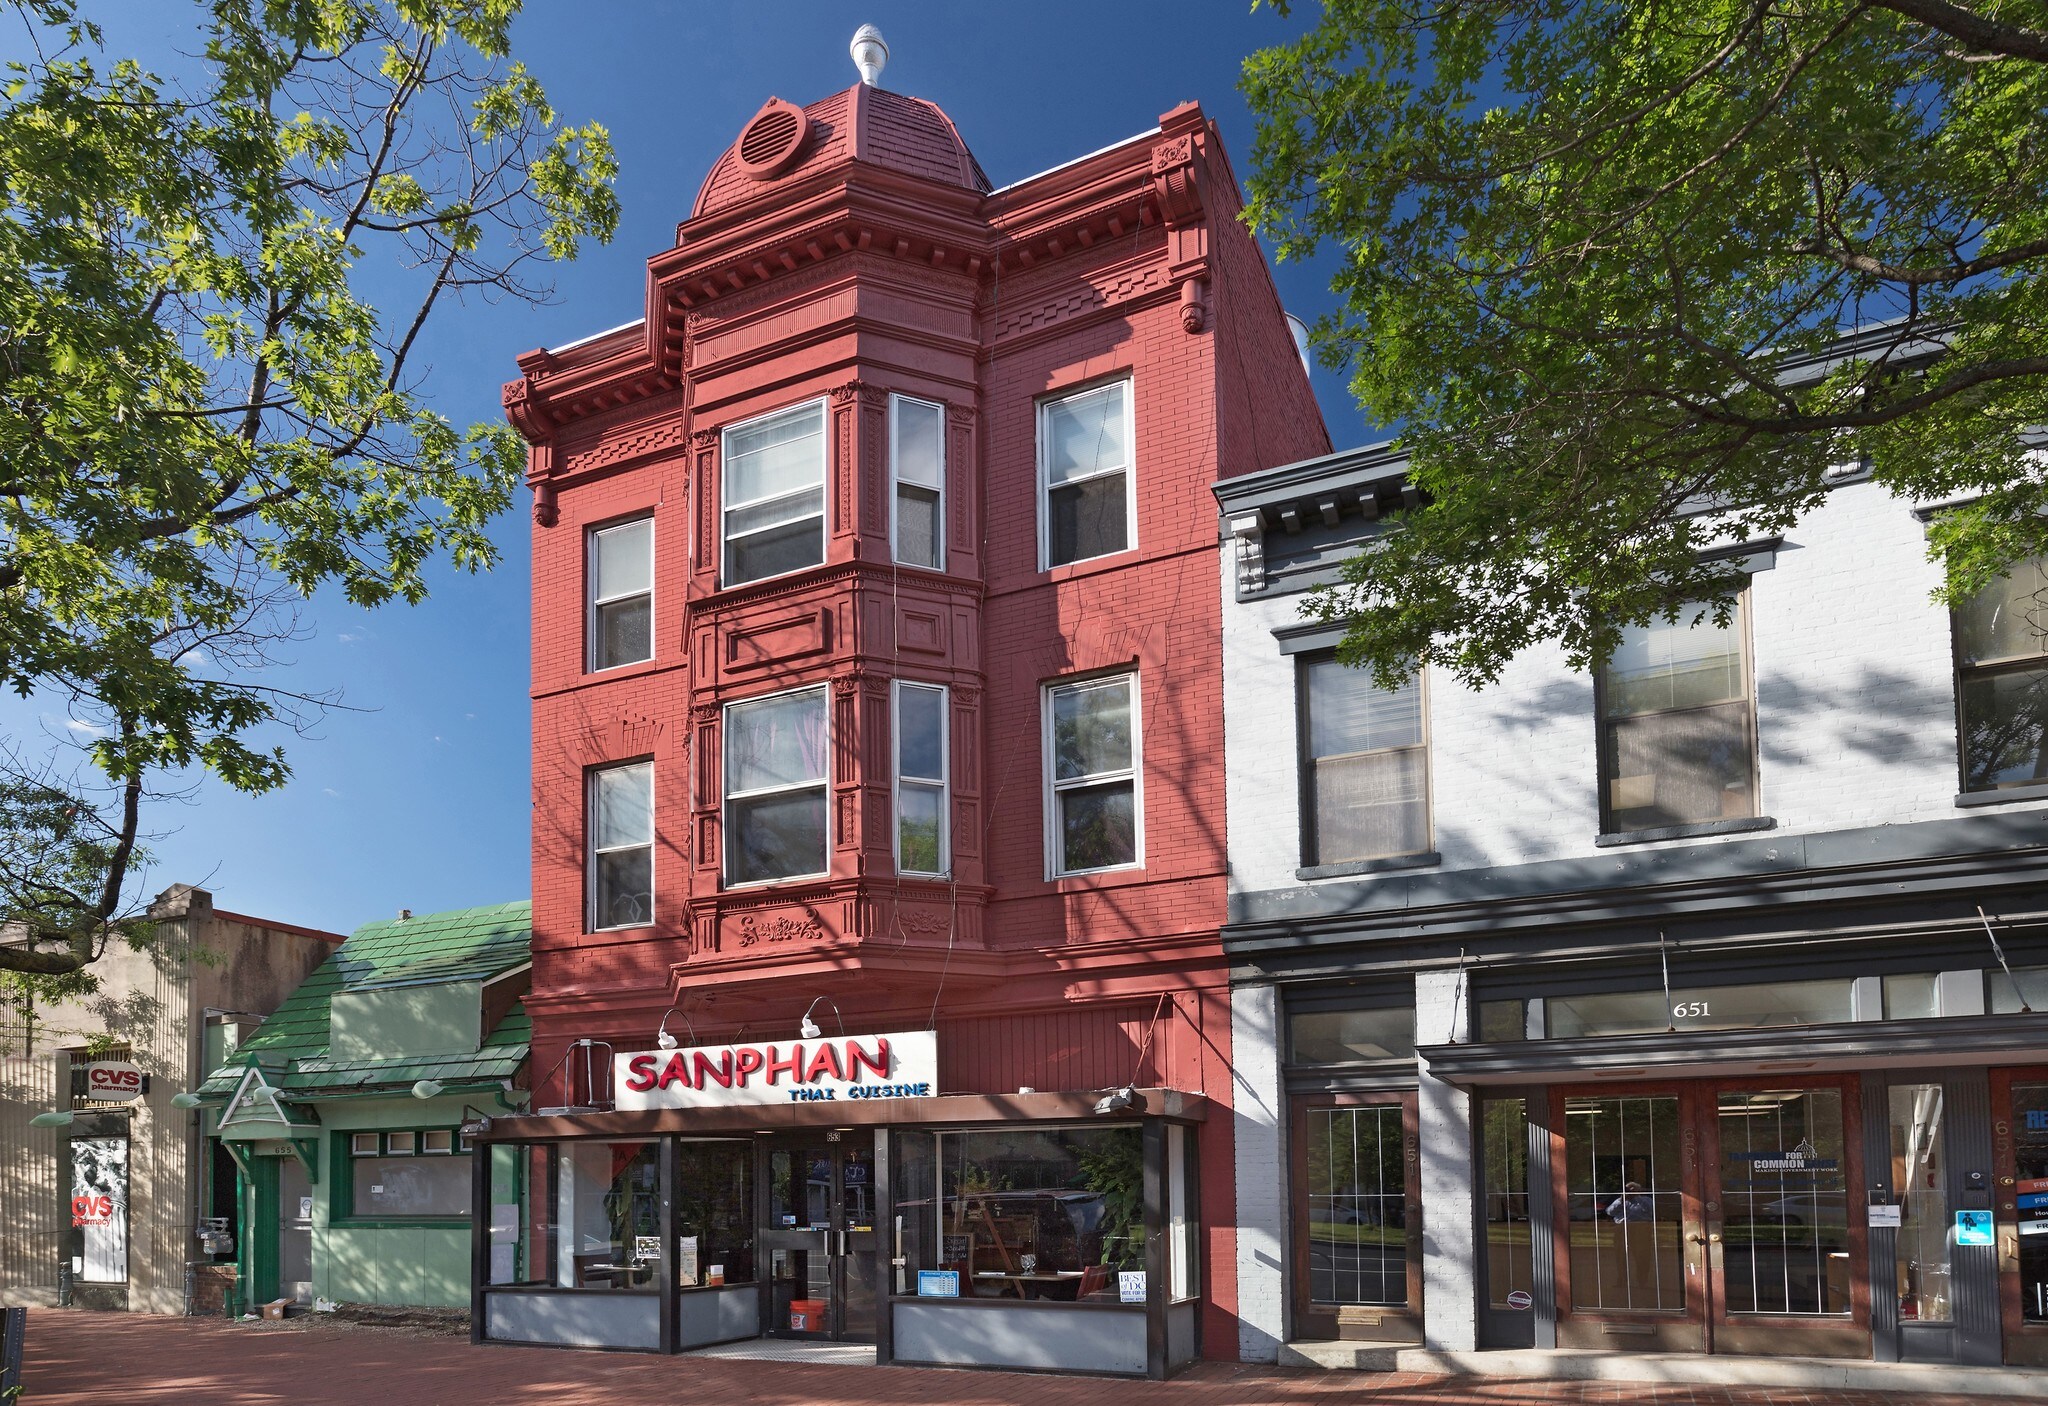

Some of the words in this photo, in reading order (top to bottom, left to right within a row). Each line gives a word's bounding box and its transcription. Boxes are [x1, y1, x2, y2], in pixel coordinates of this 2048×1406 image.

[1673, 1001, 1711, 1018] 651
[626, 1037, 890, 1092] SANPHAN
[91, 1068, 140, 1086] CVS
[92, 1083, 139, 1094] pharmacy
[788, 1088, 836, 1101] THAI
[848, 1082, 930, 1099] CUISINE
[826, 1132, 841, 1142] 653
[275, 1146, 292, 1154] 655
[1407, 1135, 1416, 1176] 651
[1785, 1152, 1803, 1160] FOR
[1754, 1159, 1805, 1169] COMMON
[72, 1195, 112, 1217] CVS
[73, 1217, 111, 1228] pharmacy
[1120, 1274, 1145, 1282] BEST
